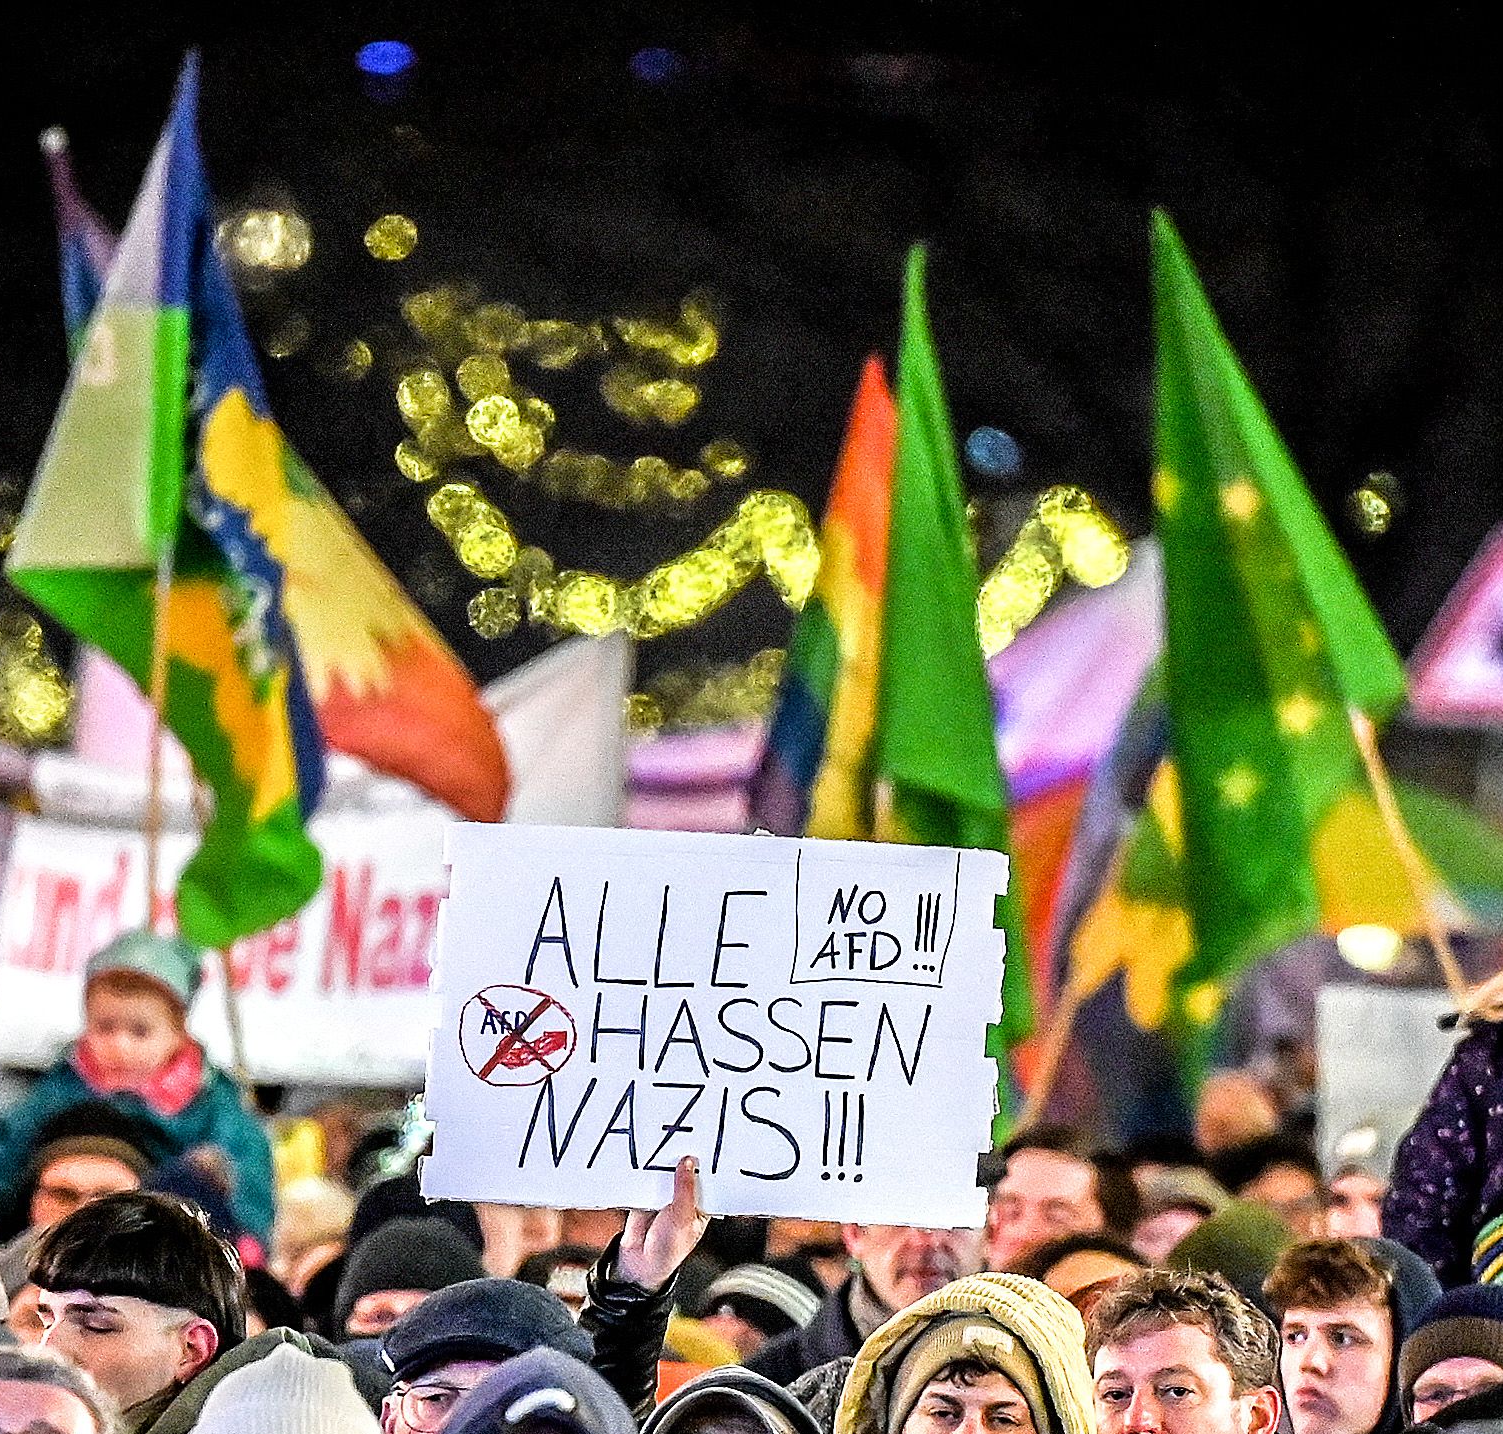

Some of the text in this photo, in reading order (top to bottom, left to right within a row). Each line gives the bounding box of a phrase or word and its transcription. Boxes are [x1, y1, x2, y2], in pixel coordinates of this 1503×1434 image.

[525, 876, 768, 988] ALLE
[827, 884, 887, 925] NO
[809, 930, 902, 971] AFD
[590, 991, 932, 1086] HASSEN
